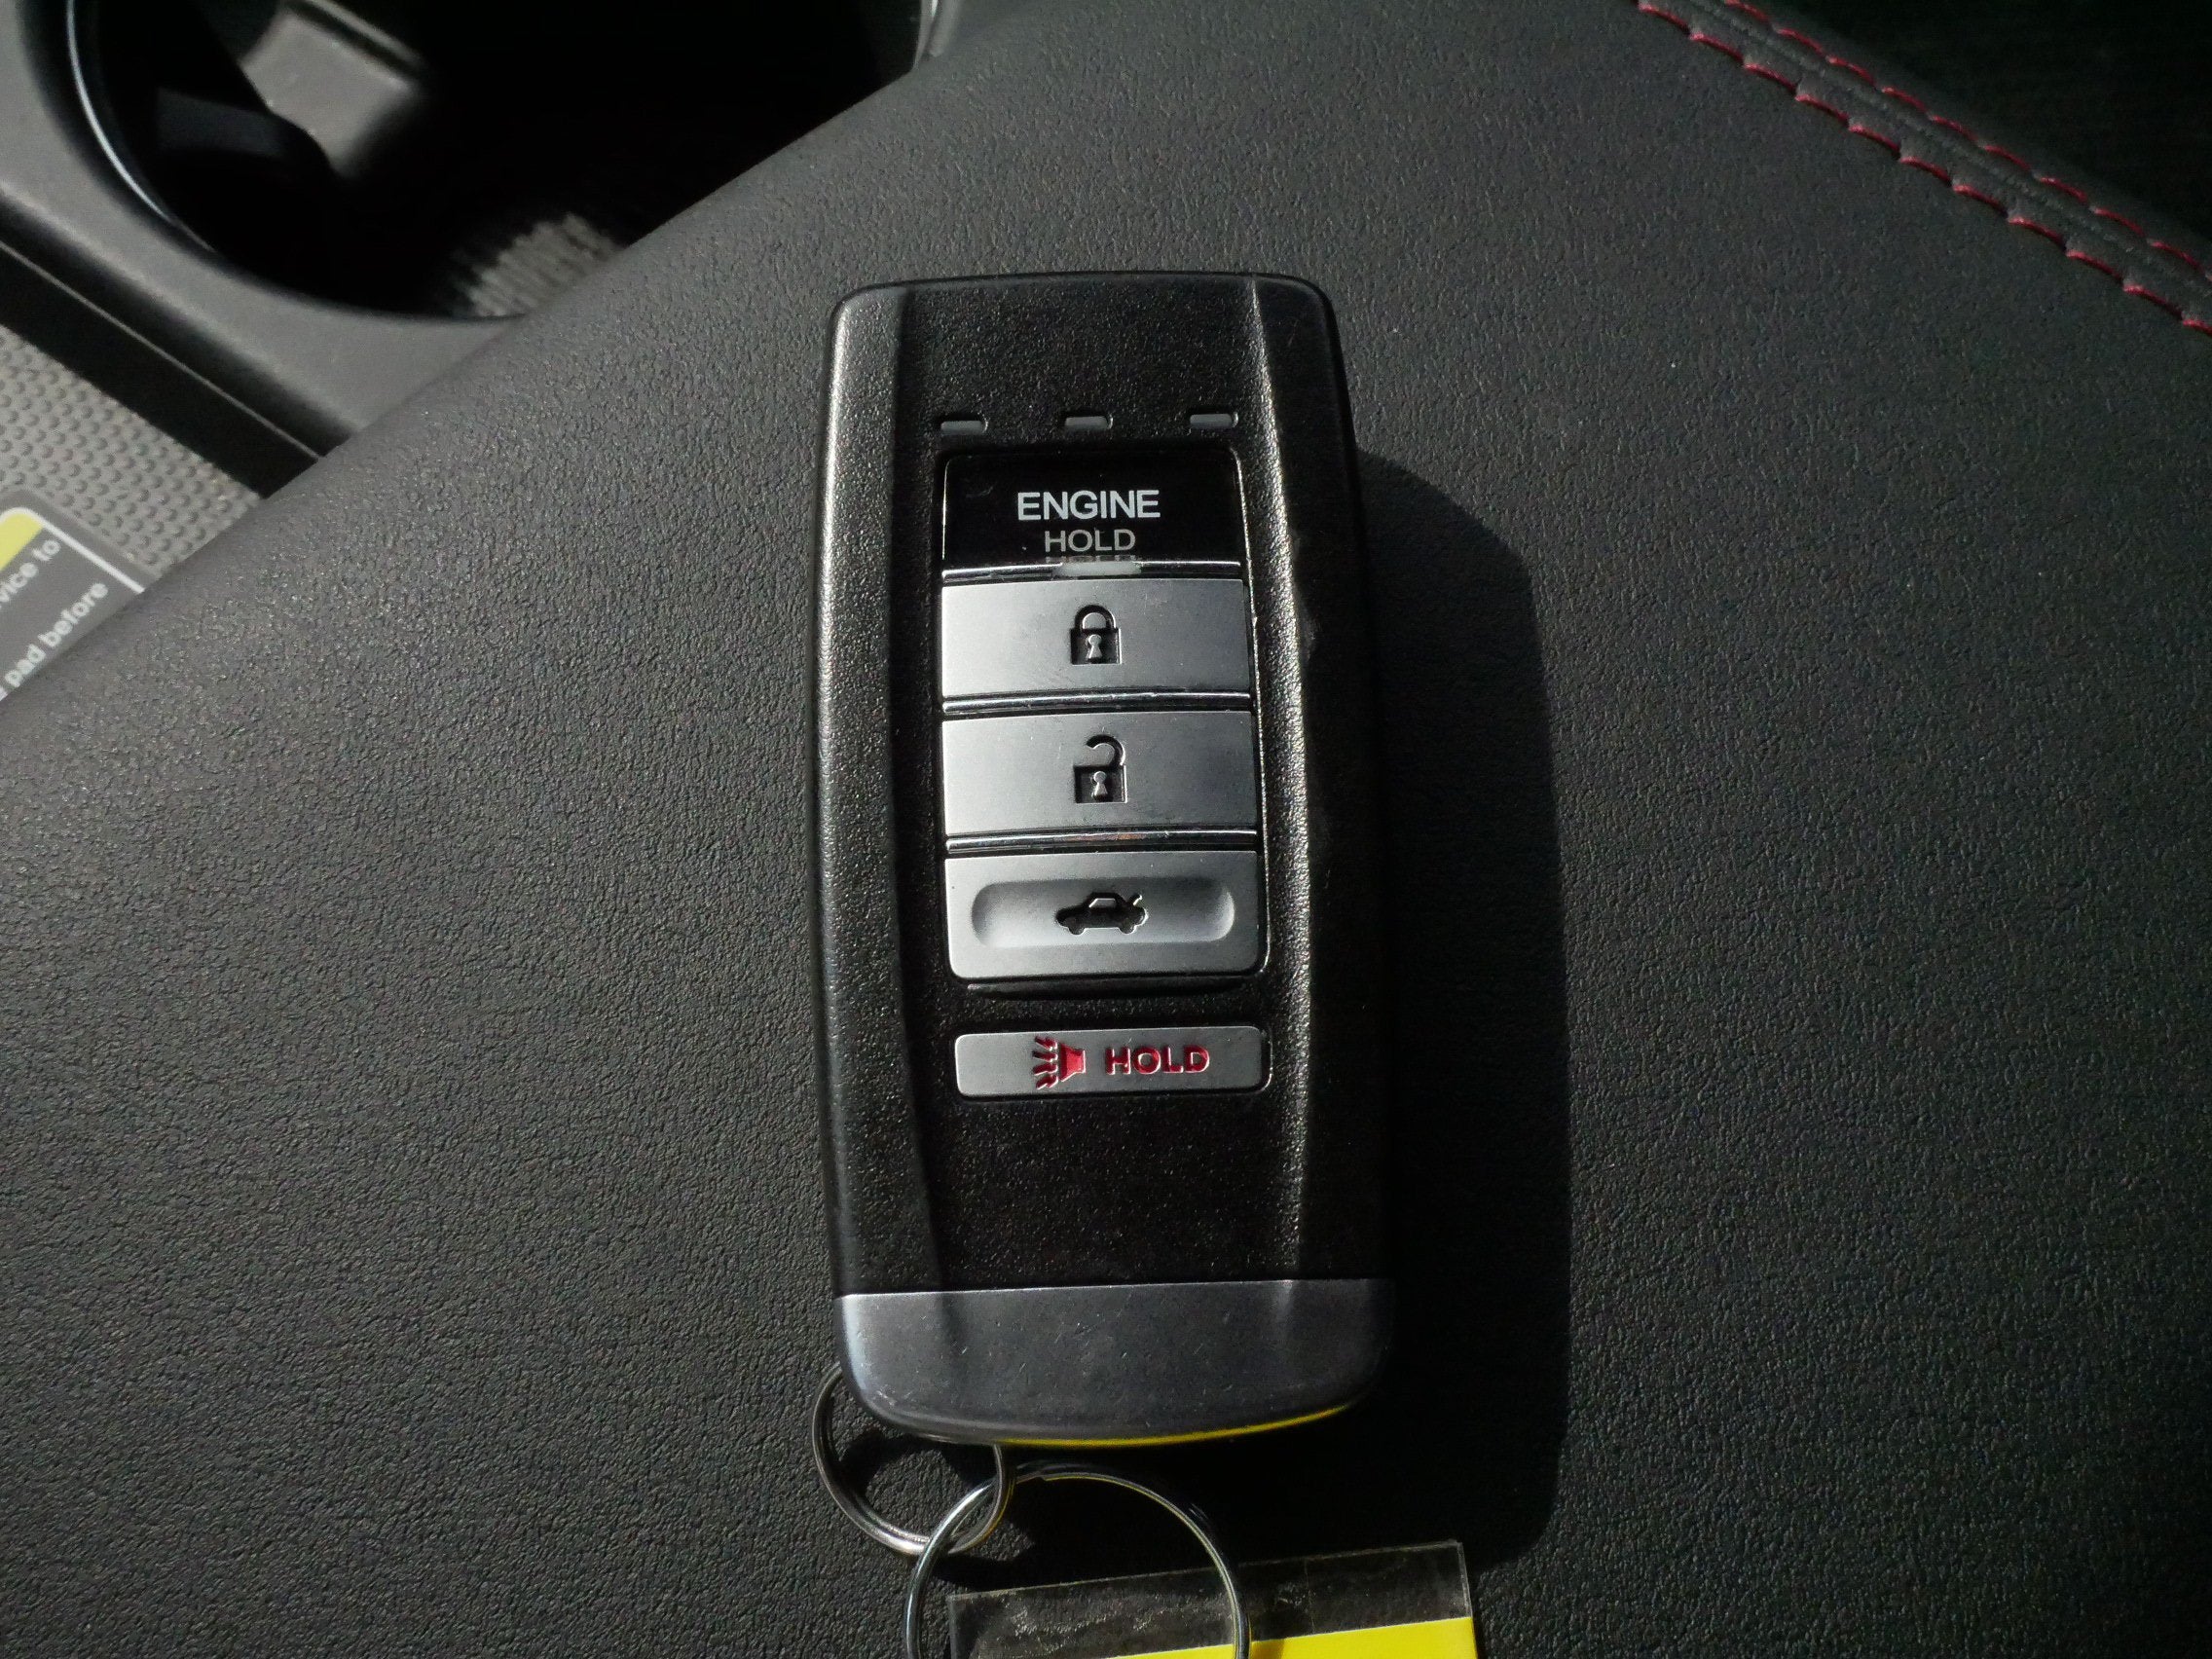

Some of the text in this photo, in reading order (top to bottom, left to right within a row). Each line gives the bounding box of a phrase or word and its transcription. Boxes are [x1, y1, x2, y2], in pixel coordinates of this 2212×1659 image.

[1017, 490, 1161, 521] ENGINE
[31, 539, 61, 562] to
[1044, 529, 1136, 553] HOLD
[4, 583, 109, 688] pad before
[1104, 1045, 1210, 1075] HOLD
